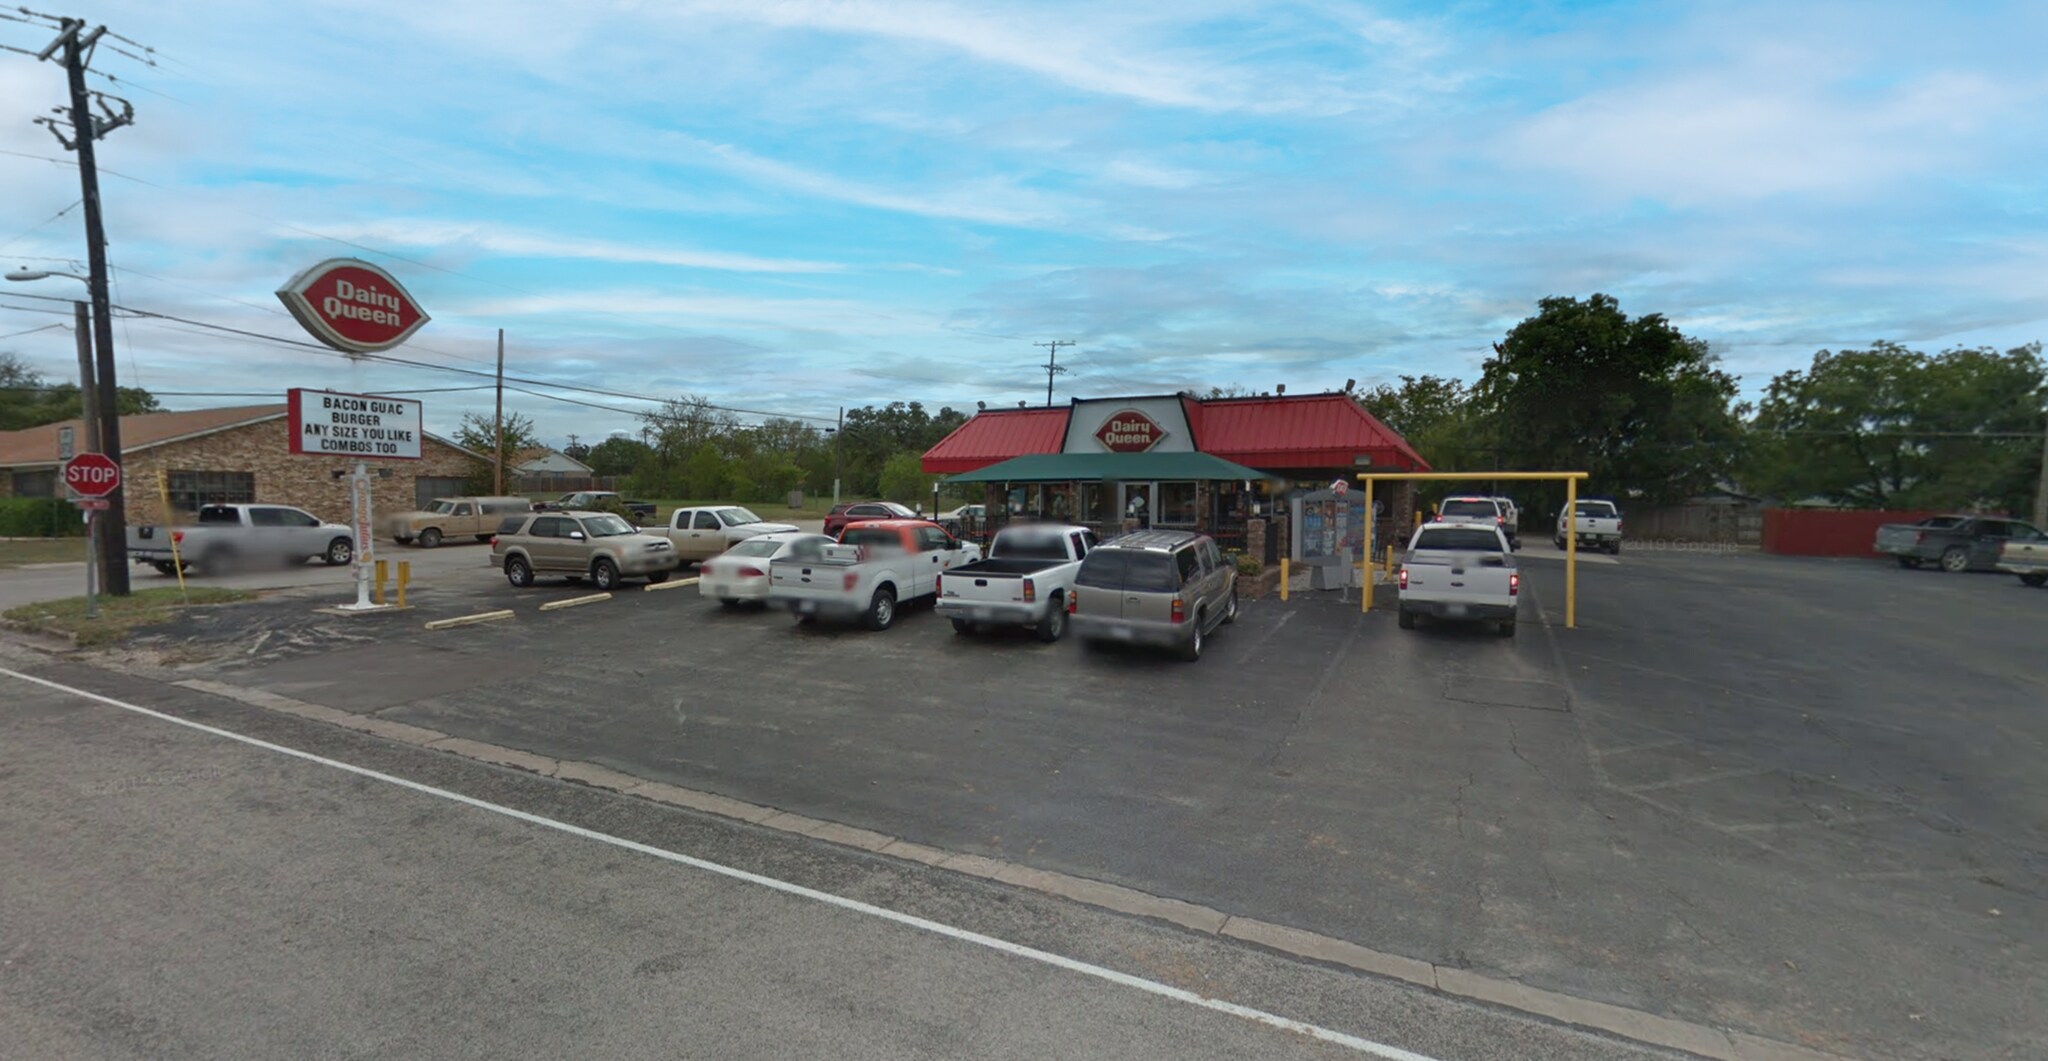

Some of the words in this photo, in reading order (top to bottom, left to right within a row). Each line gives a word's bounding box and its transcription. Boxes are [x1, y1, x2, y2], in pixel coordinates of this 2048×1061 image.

[336, 279, 400, 312] Dairy
[323, 296, 400, 327] Queen
[323, 397, 368, 412] BACON
[370, 401, 403, 415] GUAC
[332, 412, 381, 426] BURGER
[1112, 419, 1150, 433] Dairy
[304, 423, 329, 436] ANY
[332, 426, 358, 438] SIZE
[361, 428, 384, 440] YOU
[387, 430, 412, 442] LIKE
[1105, 432, 1150, 446] Queen
[321, 439, 373, 453] COMBOS
[375, 443, 397, 454] TOO
[68, 465, 115, 483] STOP
